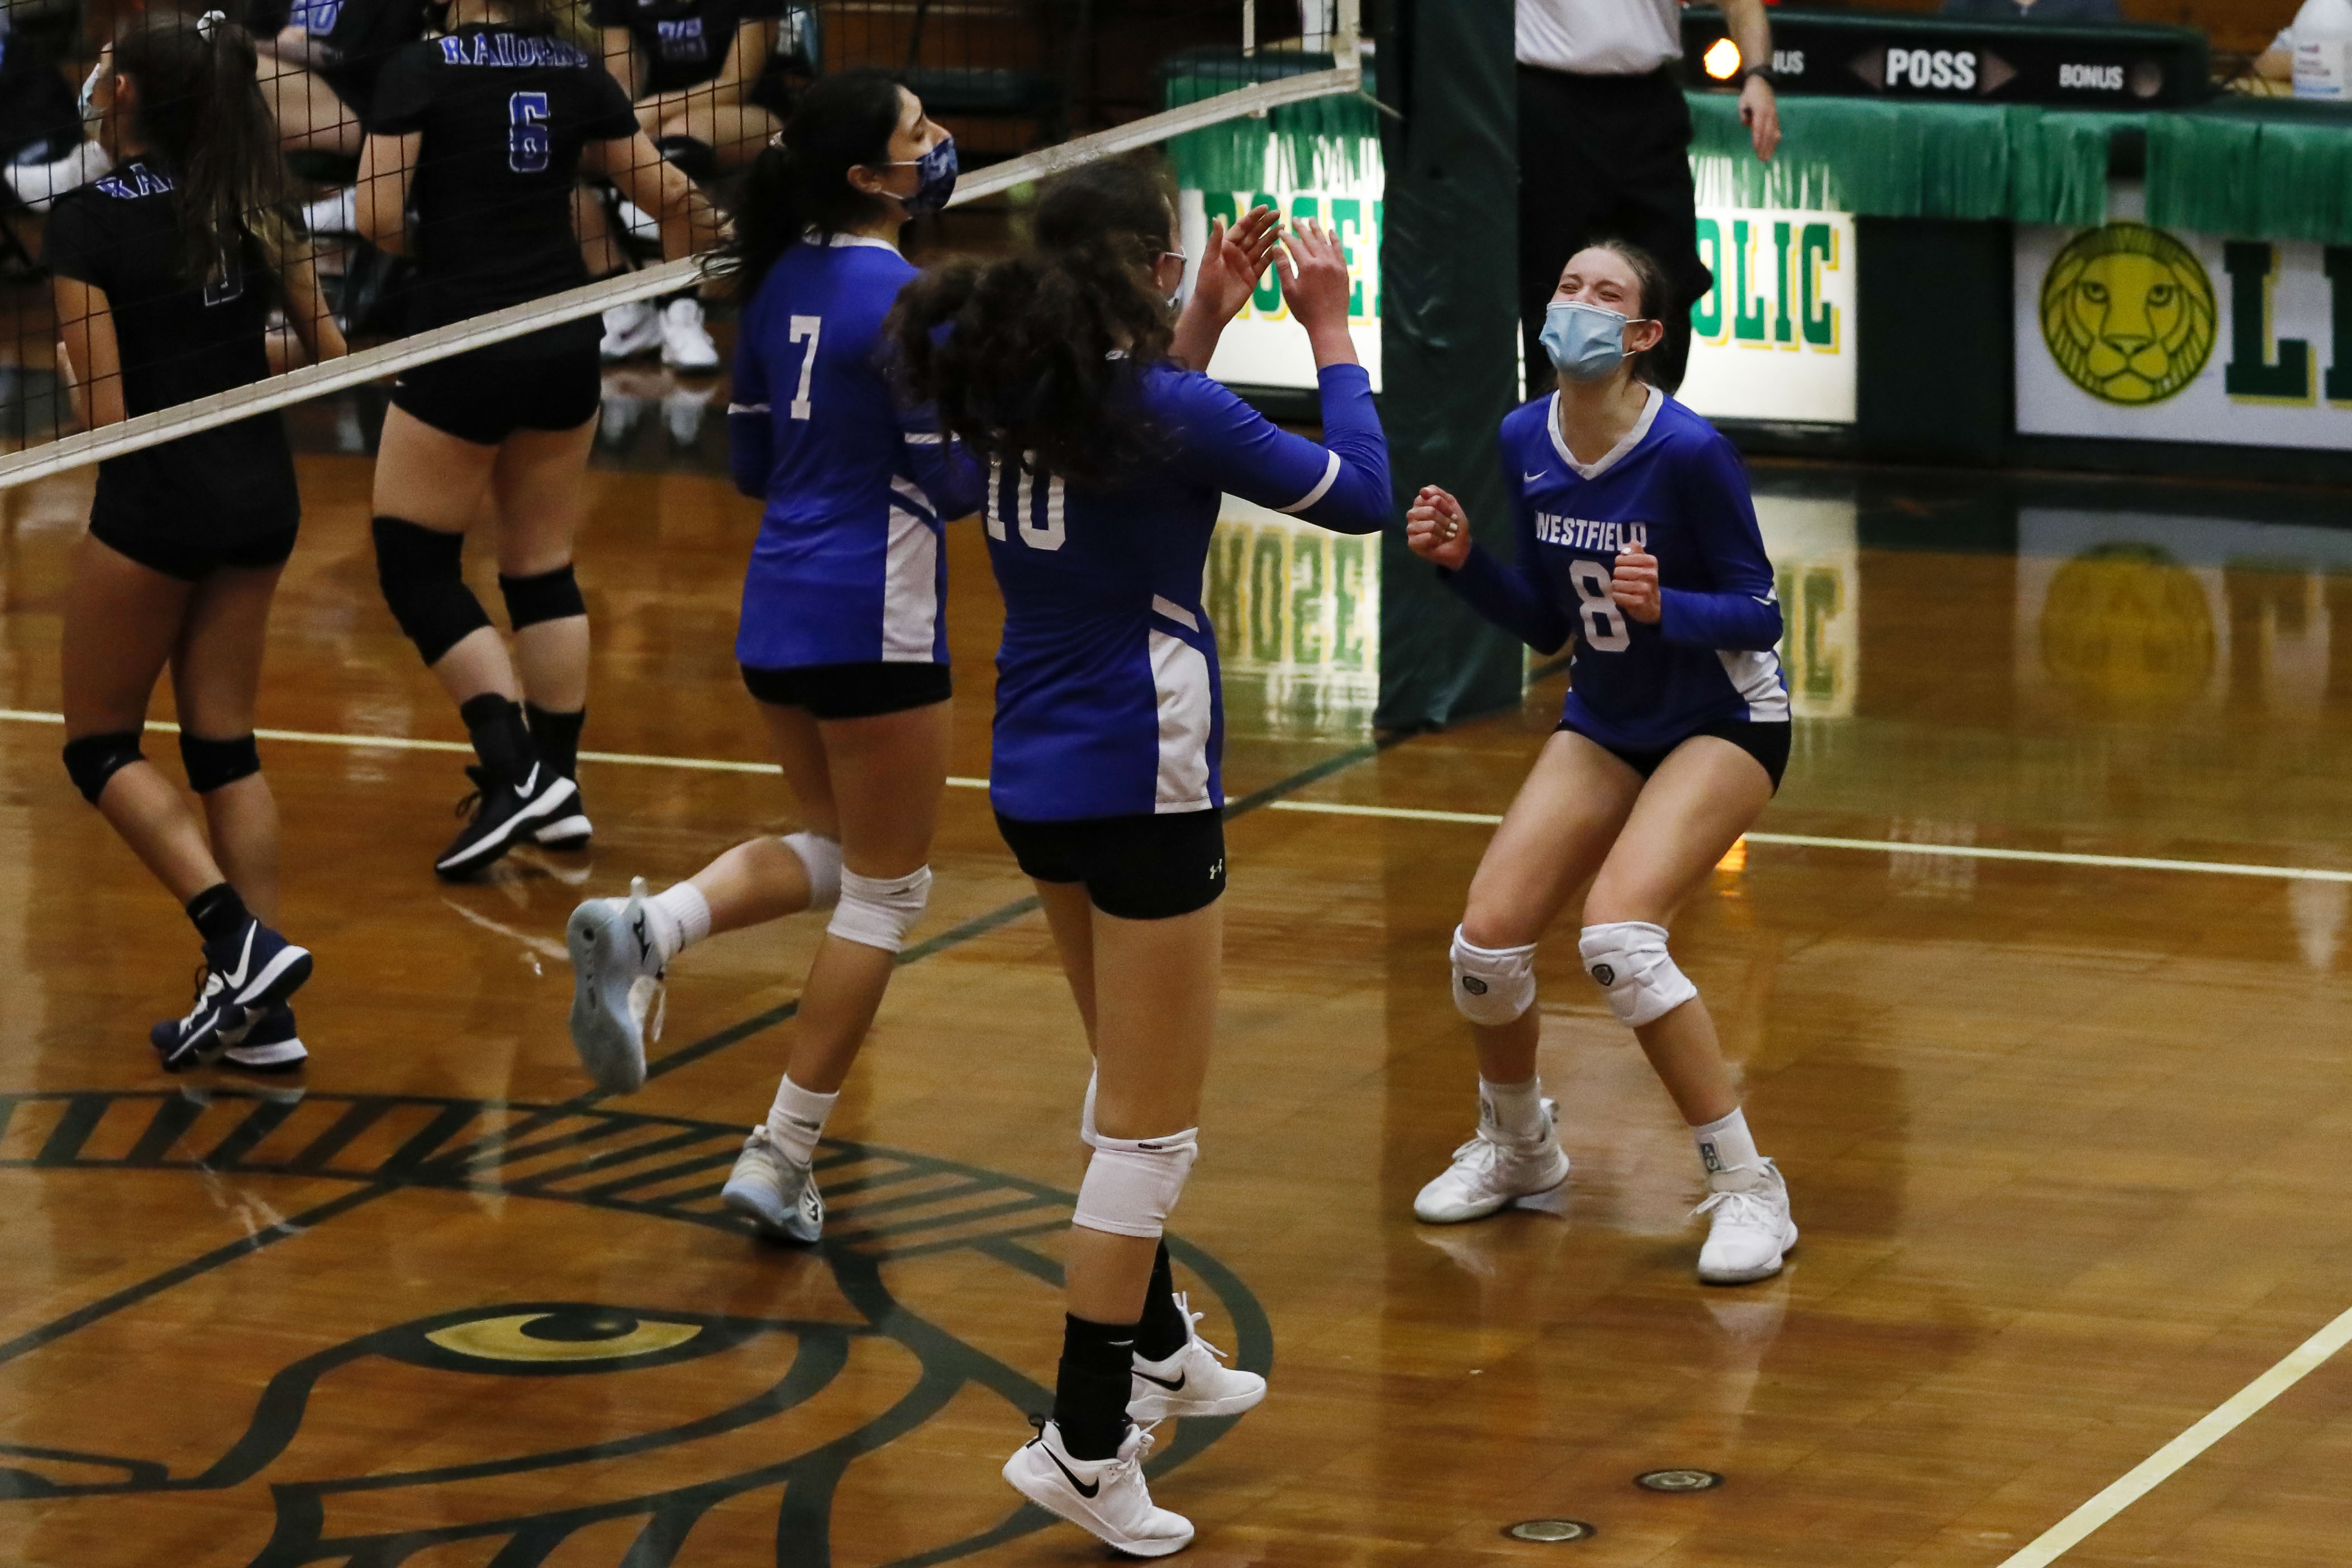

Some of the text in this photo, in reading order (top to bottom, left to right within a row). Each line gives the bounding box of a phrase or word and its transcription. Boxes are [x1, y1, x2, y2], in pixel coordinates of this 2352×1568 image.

[1772, 48, 1805, 74] US
[1886, 47, 1977, 90] POSS
[2059, 63, 2124, 89] BONUS
[510, 91, 550, 172] 6
[789, 314, 821, 420] 7
[985, 450, 1066, 551] 10
[1535, 511, 1648, 552] WESTFIELD
[1568, 559, 1630, 652] 8
